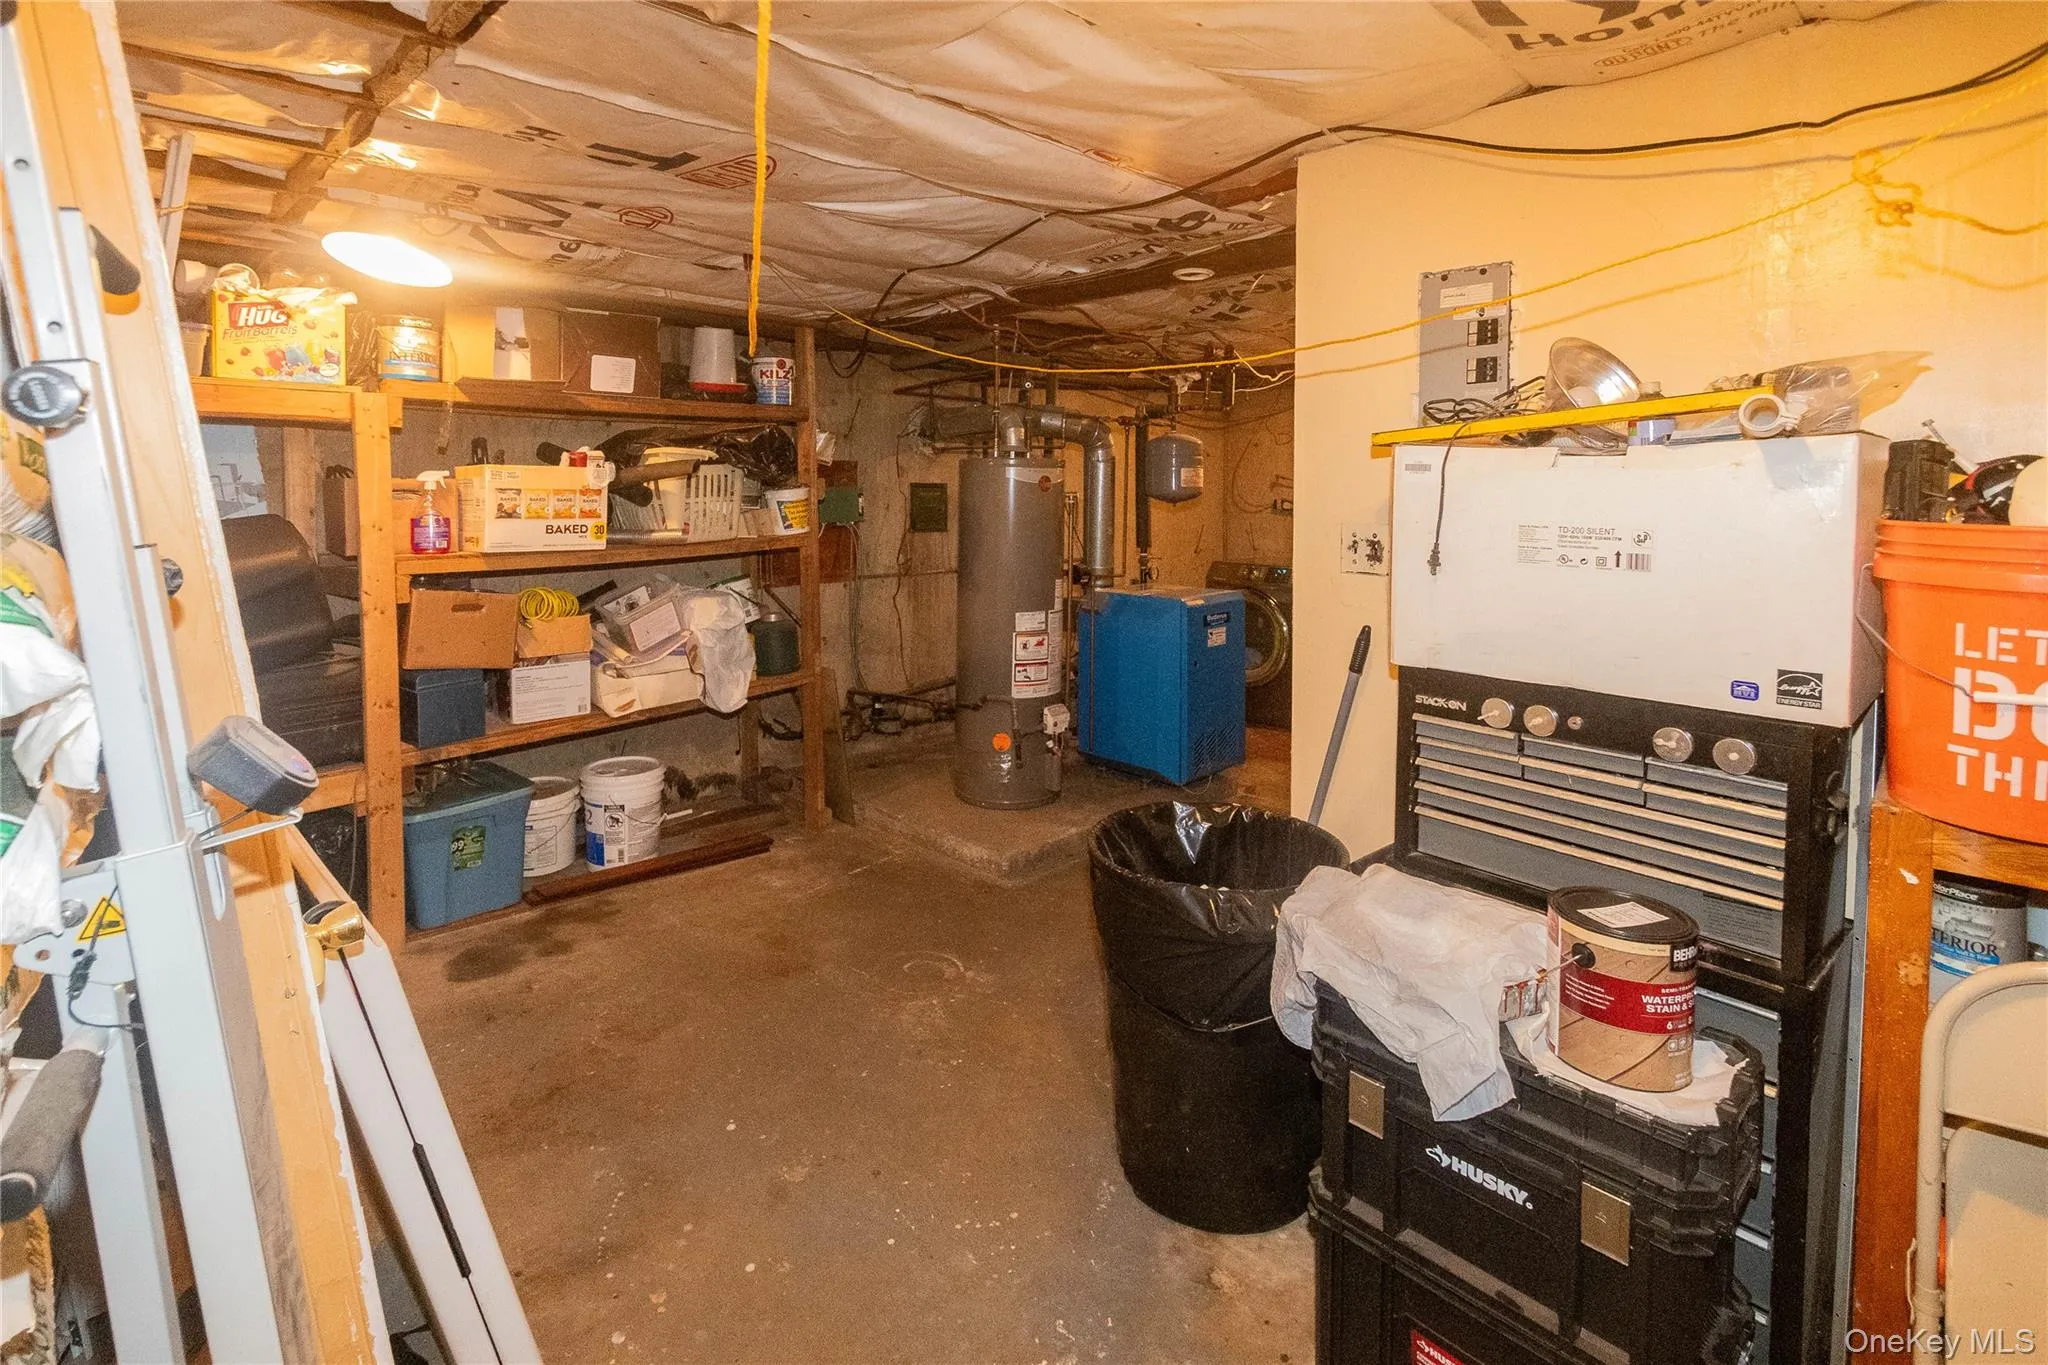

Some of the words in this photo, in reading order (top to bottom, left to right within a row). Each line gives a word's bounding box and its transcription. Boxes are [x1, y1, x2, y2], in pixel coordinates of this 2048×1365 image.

[222, 327, 252, 340] Fruit
[253, 325, 298, 337] Barrels
[760, 369, 790, 380] KILZ
[545, 524, 589, 535] BAKED
[594, 524, 605, 535] 30
[1558, 526, 1585, 535] TD-200
[1586, 527, 1616, 536] SILENT
[1415, 694, 1467, 711] STACK-ON
[1777, 696, 1803, 706] ENERGY
[1803, 700, 1822, 709] STAR
[1932, 882, 1979, 900] olorPlace
[1932, 927, 1999, 958] TERIOR
[1646, 1003, 1680, 1013] STAIN
[1681, 1002, 1688, 1010] &
[1666, 1021, 1673, 1030] 6
[1451, 1155, 1528, 1206] HUSKY
